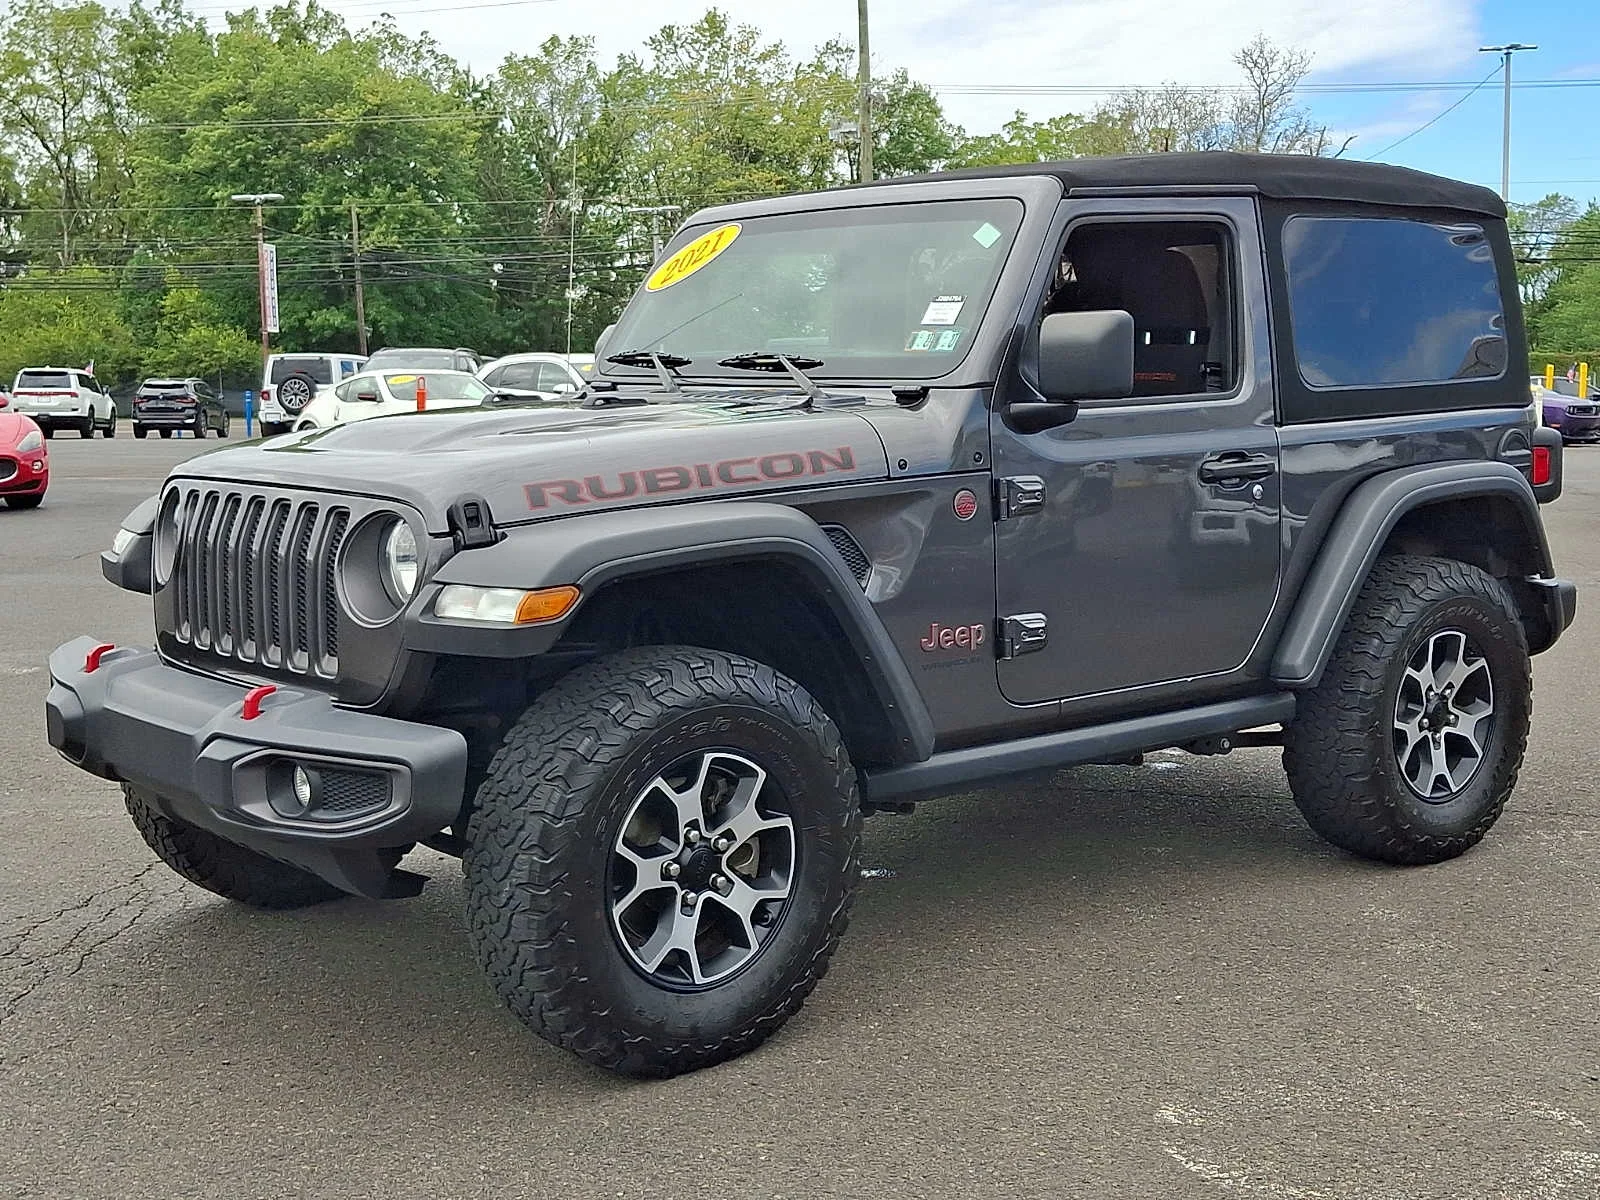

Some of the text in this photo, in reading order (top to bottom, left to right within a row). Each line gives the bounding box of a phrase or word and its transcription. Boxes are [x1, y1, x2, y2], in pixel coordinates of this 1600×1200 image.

[660, 230, 725, 285] 2021
[523, 446, 856, 511] RUBICON
[920, 622, 985, 652] Jeep
